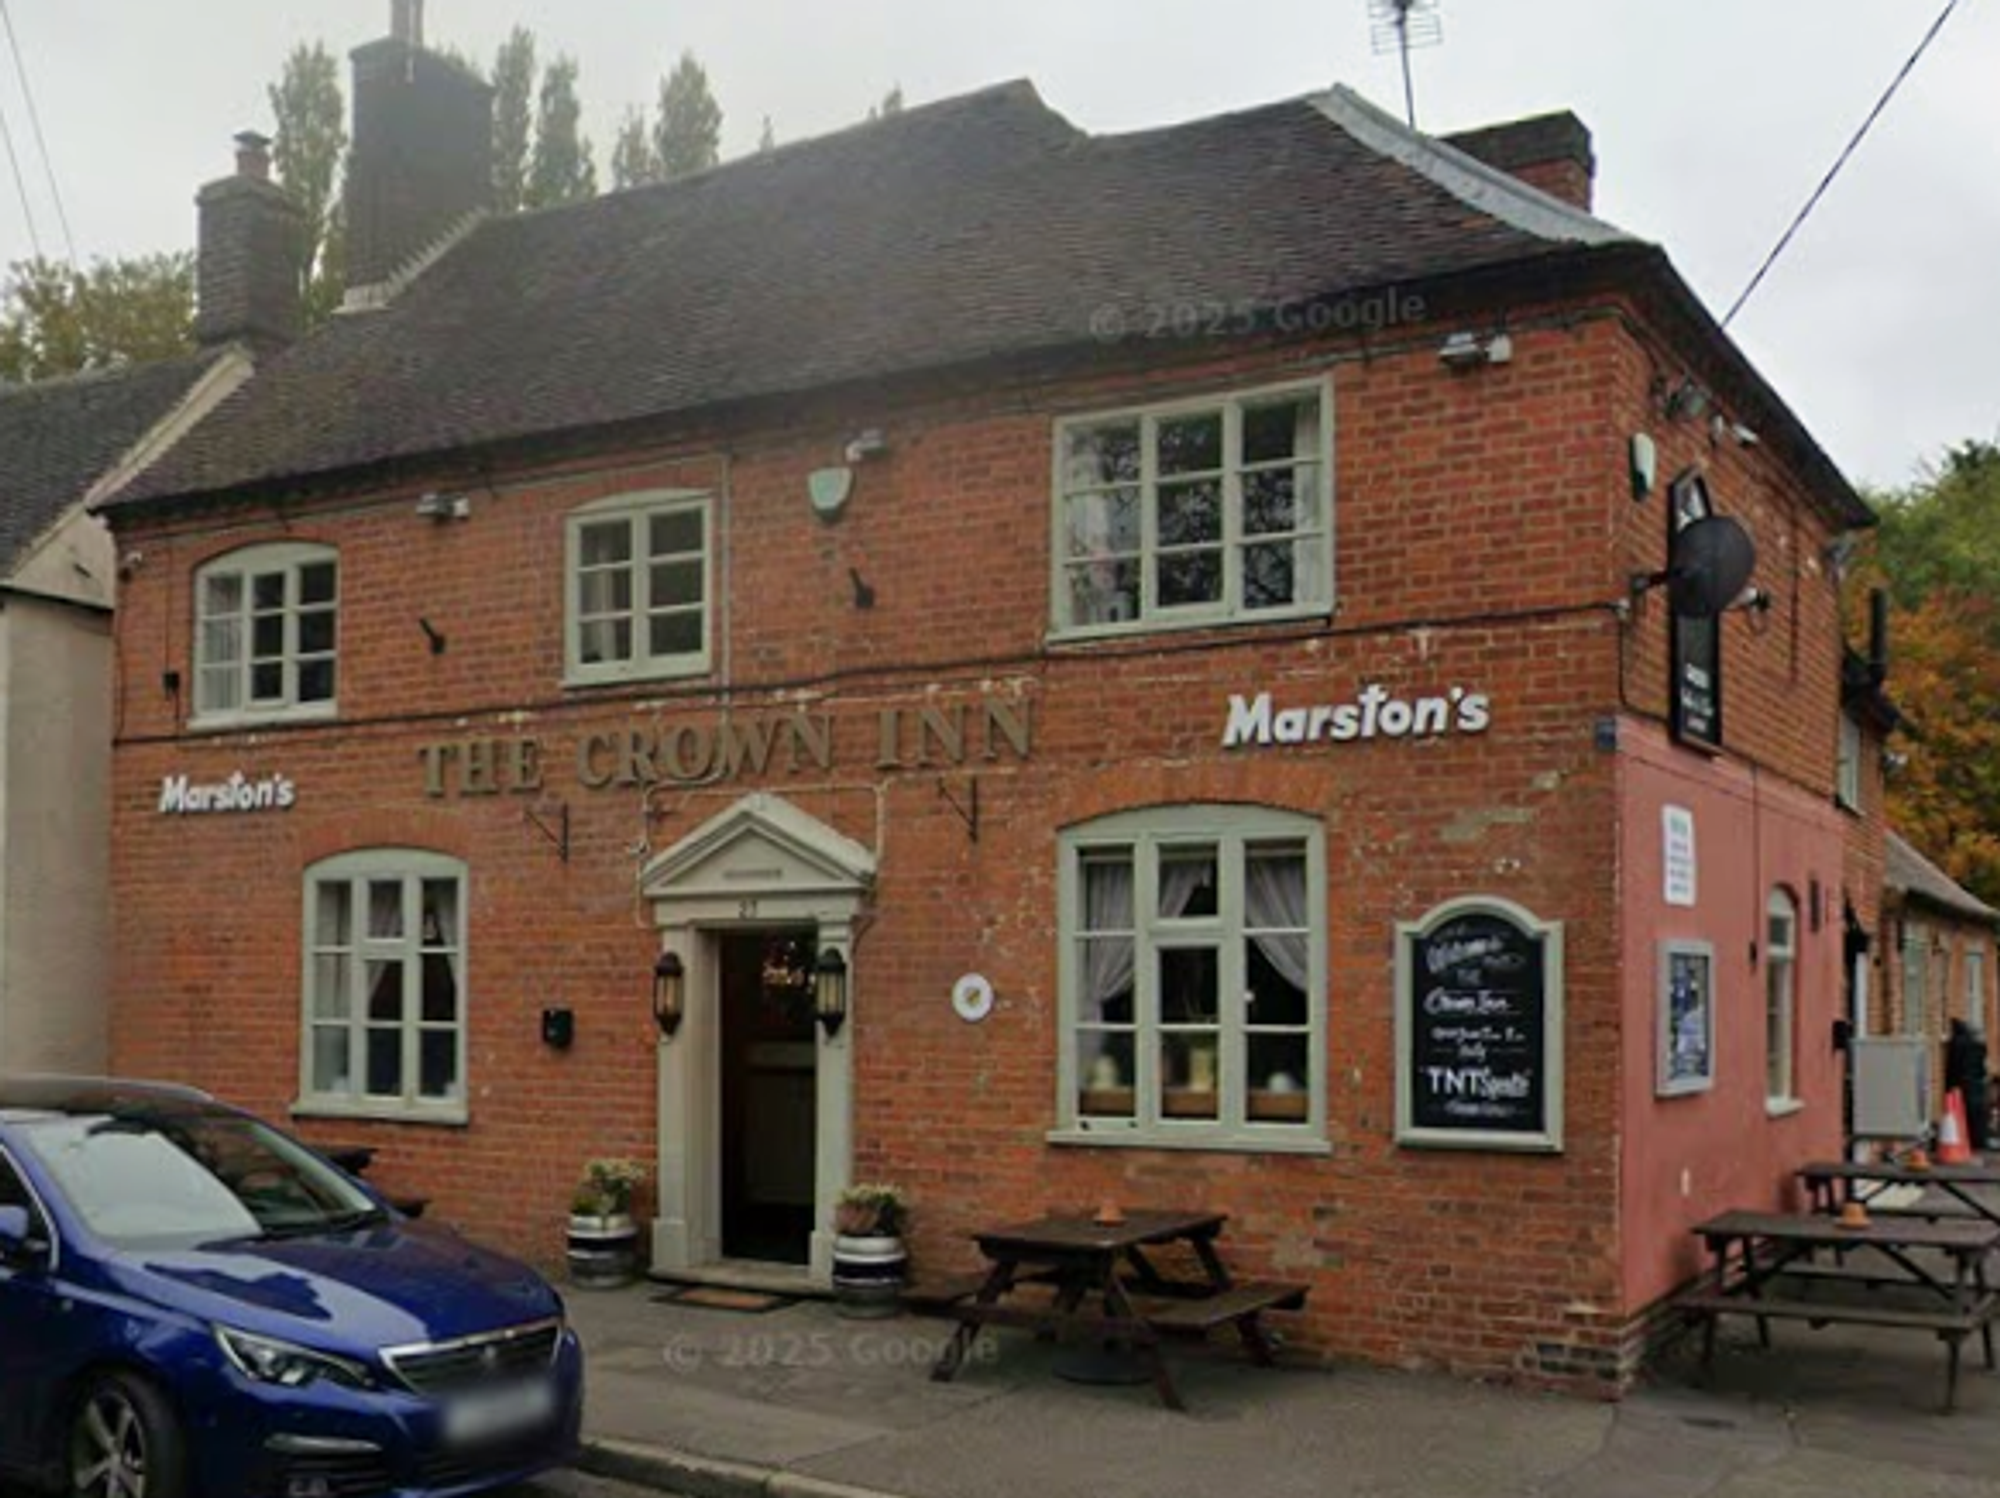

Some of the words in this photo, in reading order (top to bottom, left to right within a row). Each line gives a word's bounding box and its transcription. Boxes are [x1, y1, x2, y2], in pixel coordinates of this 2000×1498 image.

[1221, 683, 1490, 746] Marston's
[418, 737, 545, 799] THE
[576, 710, 836, 789] CROWN
[873, 697, 1036, 770] INN
[158, 770, 296, 813] Marston's
